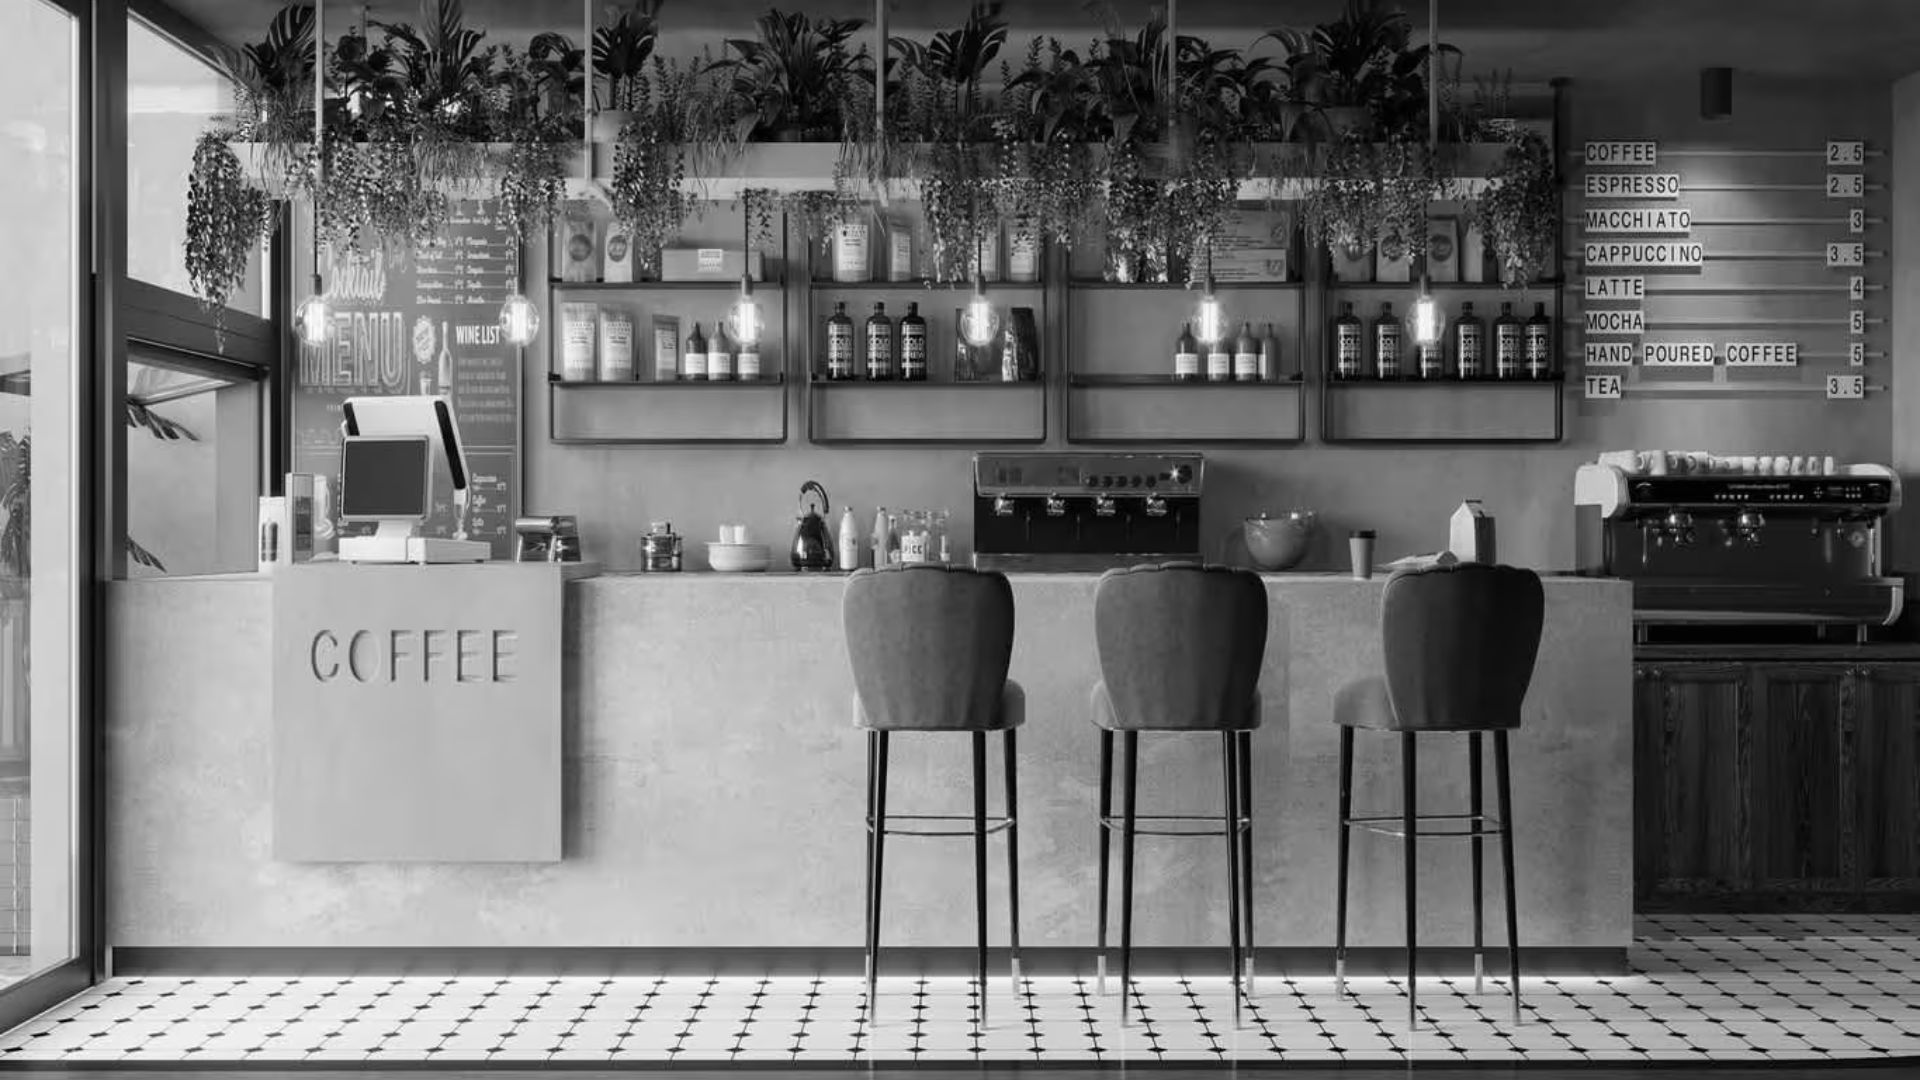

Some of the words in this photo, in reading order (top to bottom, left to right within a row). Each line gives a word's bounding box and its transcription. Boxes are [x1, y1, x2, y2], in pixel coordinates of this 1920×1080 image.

[1586, 144, 1654, 161] COFFEE
[1830, 145, 1863, 161] 2.5
[1586, 176, 1679, 193] ESPRESSO
[1830, 178, 1863, 194] 2.5
[1586, 211, 1690, 228] MACCHIATO
[1853, 212, 1862, 228] 3
[1586, 245, 1702, 262] CAPPUCCINO
[1830, 246, 1863, 262] 3.5
[1587, 278, 1643, 295] LATTE
[1853, 280, 1862, 295] 4
[1585, 313, 1643, 330] MOCHA
[1853, 313, 1862, 330] 5
[456, 325, 480, 344] WINE
[481, 325, 500, 344] LIST
[299, 312, 404, 388] MENU
[1586, 346, 1632, 362] HAND
[1645, 346, 1713, 362] POURED
[1727, 346, 1795, 362] COFFEE
[1853, 346, 1862, 362] 5
[1587, 378, 1620, 395] TEA
[1830, 379, 1863, 395] 3.5
[310, 628, 519, 683] COFFEE
